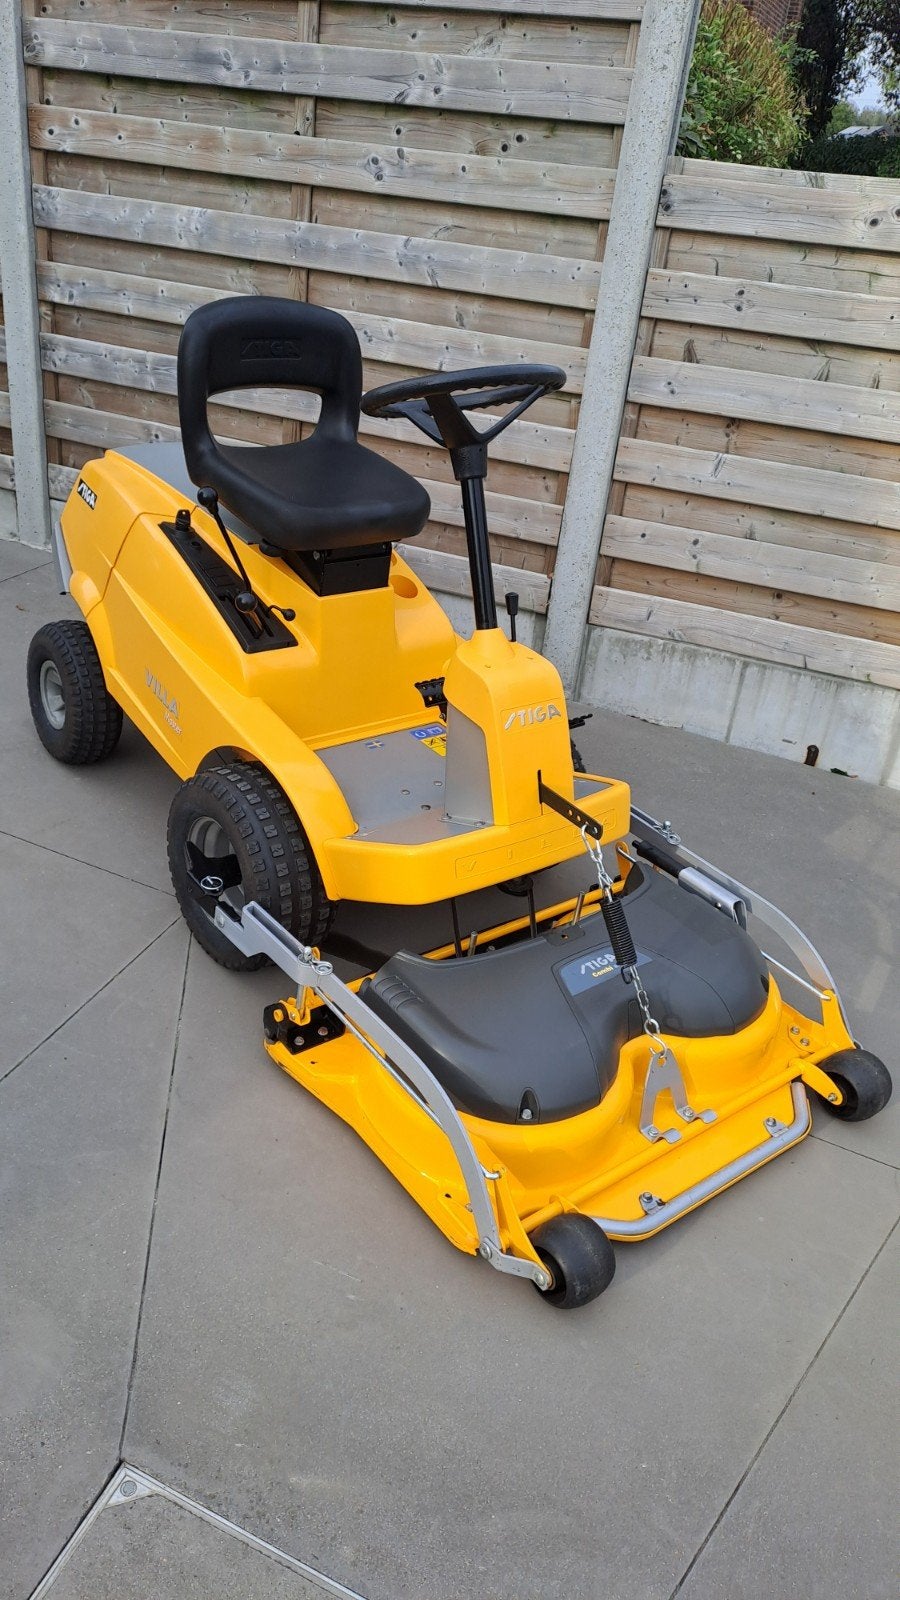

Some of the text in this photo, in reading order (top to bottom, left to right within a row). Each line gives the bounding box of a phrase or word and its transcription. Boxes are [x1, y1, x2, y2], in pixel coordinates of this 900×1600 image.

[145, 667, 179, 720] VILLA
[504, 703, 561, 730] STIGA
[580, 953, 616, 975] STIGA
[592, 965, 614, 978] Combi
